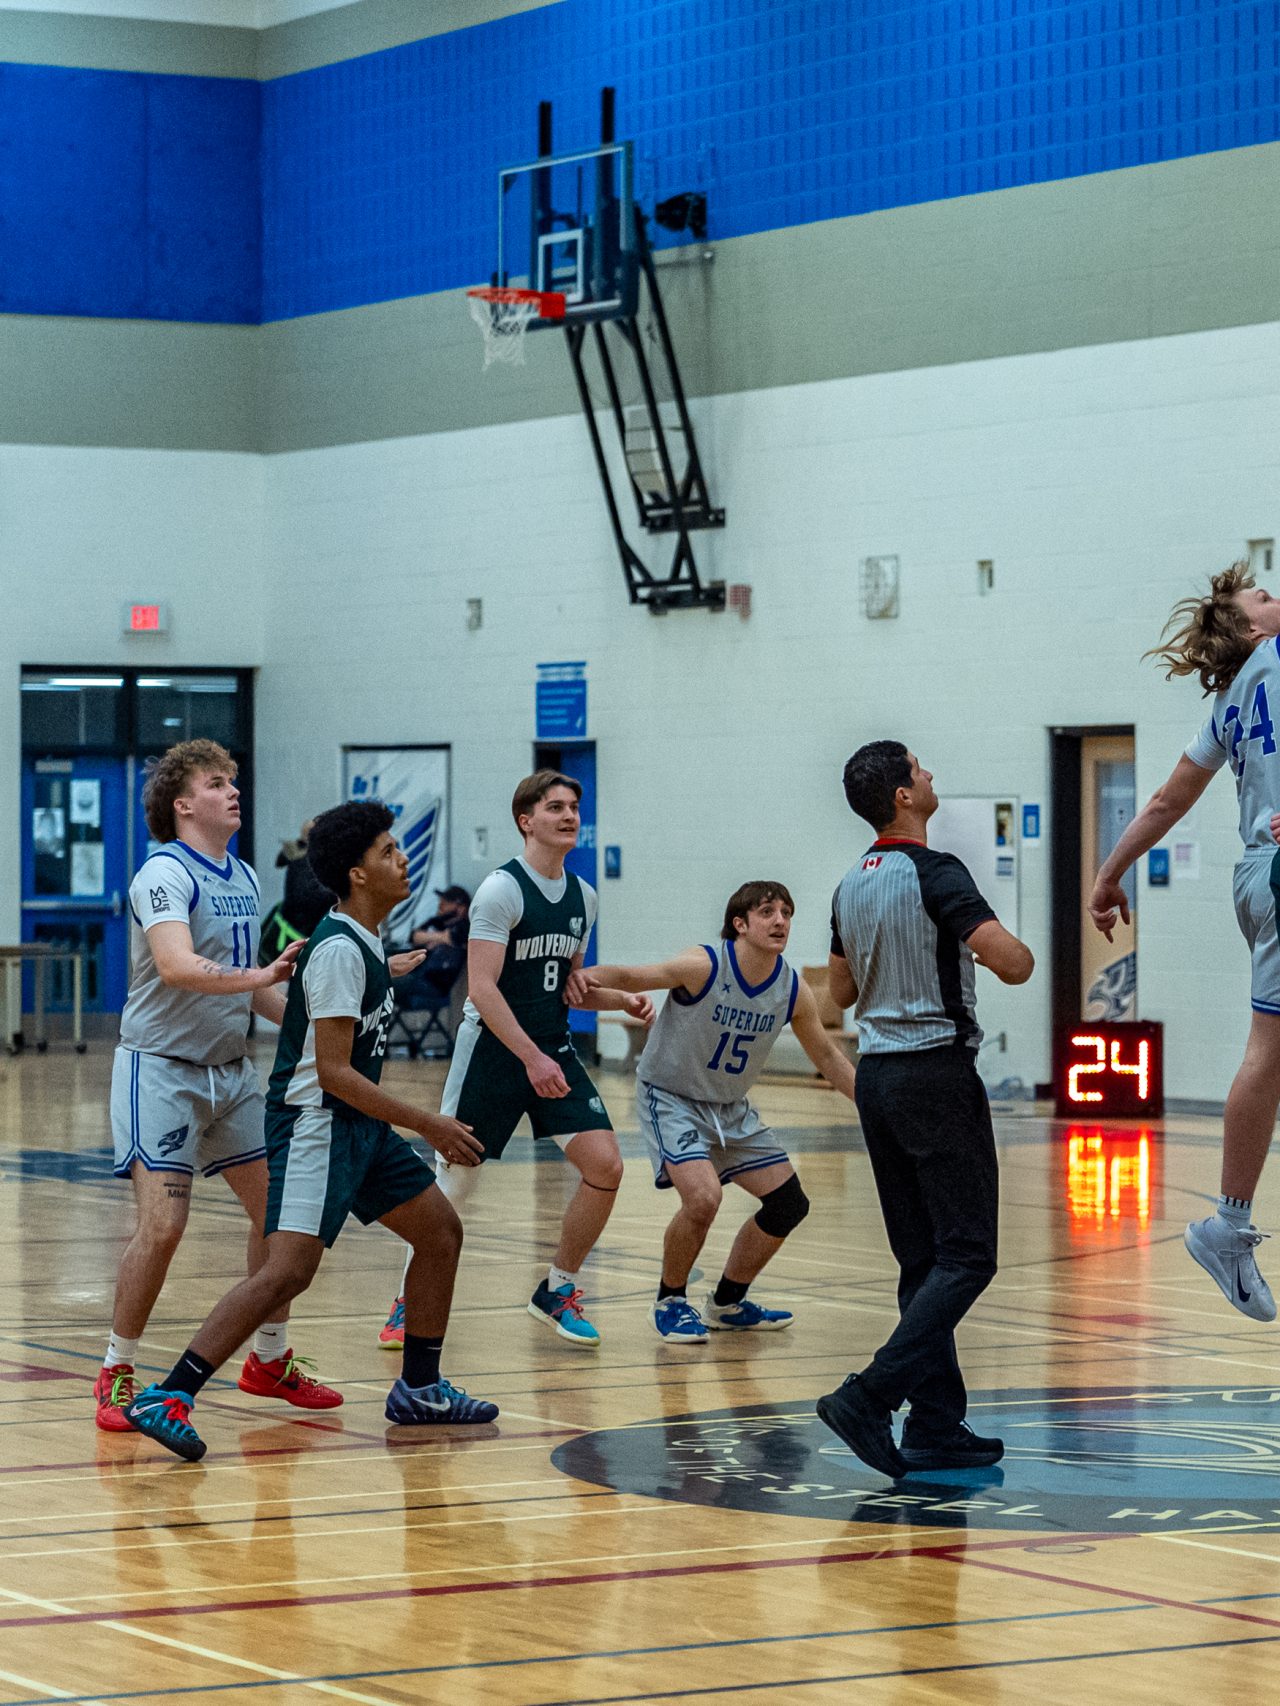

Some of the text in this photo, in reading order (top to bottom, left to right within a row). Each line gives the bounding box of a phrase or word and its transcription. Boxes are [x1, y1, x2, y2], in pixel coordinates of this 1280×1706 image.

[231, 921, 251, 969] 11
[515, 933, 581, 961] WOLVERIN
[543, 960, 560, 992] 8
[712, 1004, 776, 1033] SUPERIOR
[706, 1031, 757, 1075] 15
[1068, 1035, 1149, 1102] 24
[759, 1482, 1048, 1517] STEEL
